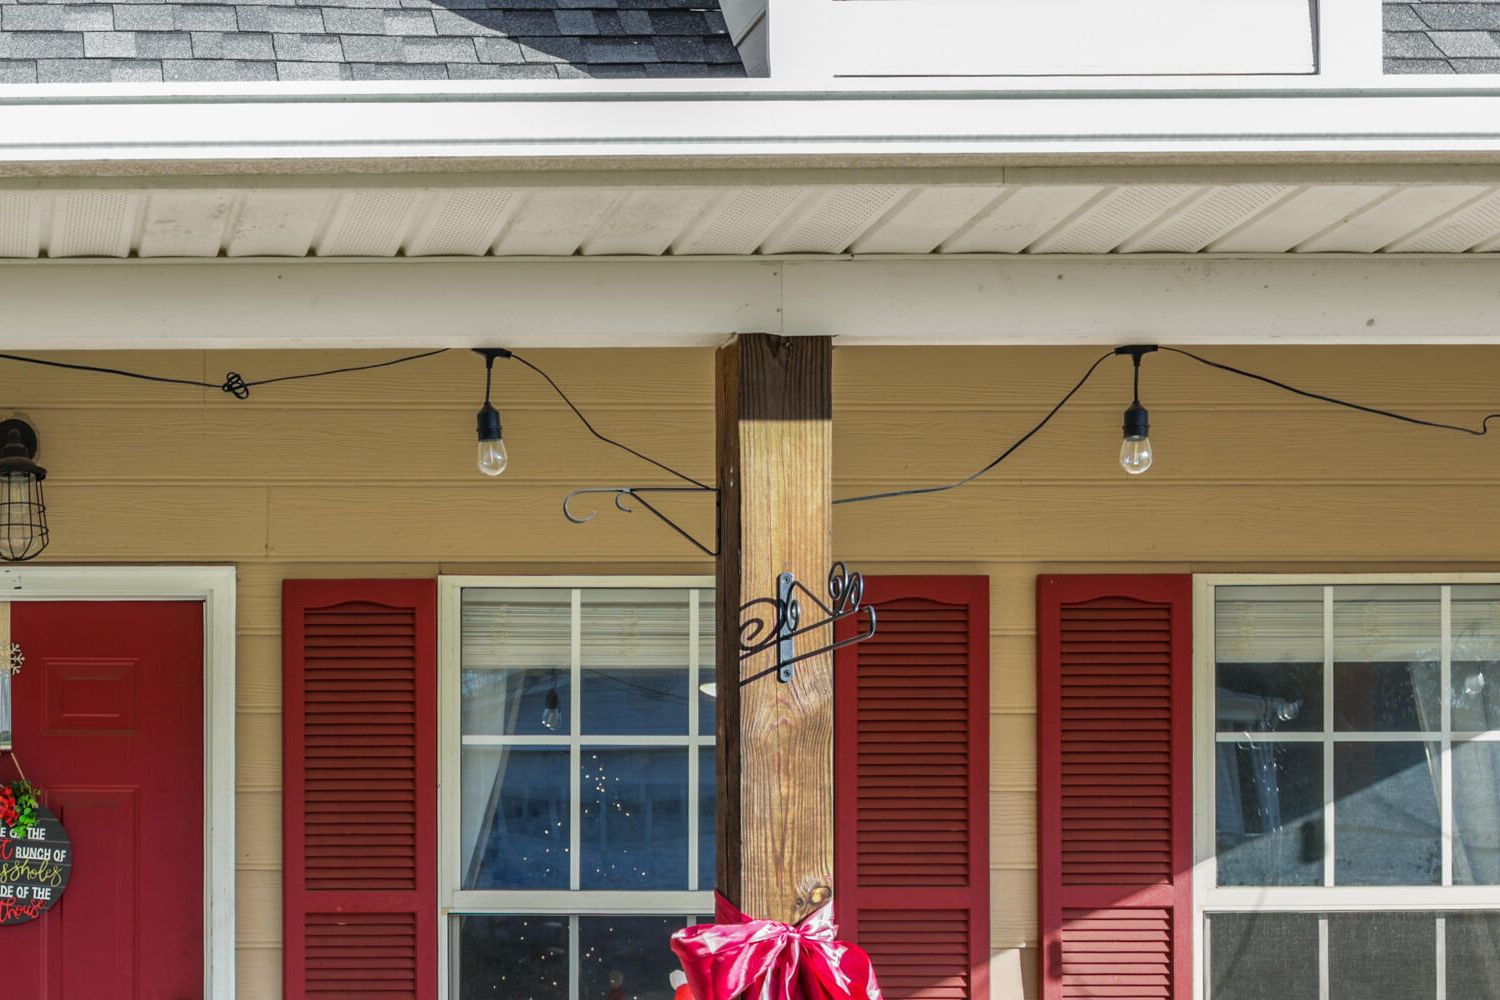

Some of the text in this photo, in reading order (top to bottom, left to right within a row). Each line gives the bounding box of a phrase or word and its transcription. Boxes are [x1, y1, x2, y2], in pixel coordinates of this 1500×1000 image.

[26, 826, 46, 840] THE
[15, 846, 51, 860] BUNCH
[53, 849, 67, 862] OF
[16, 886, 29, 898] OF
[31, 886, 52, 900] THE
